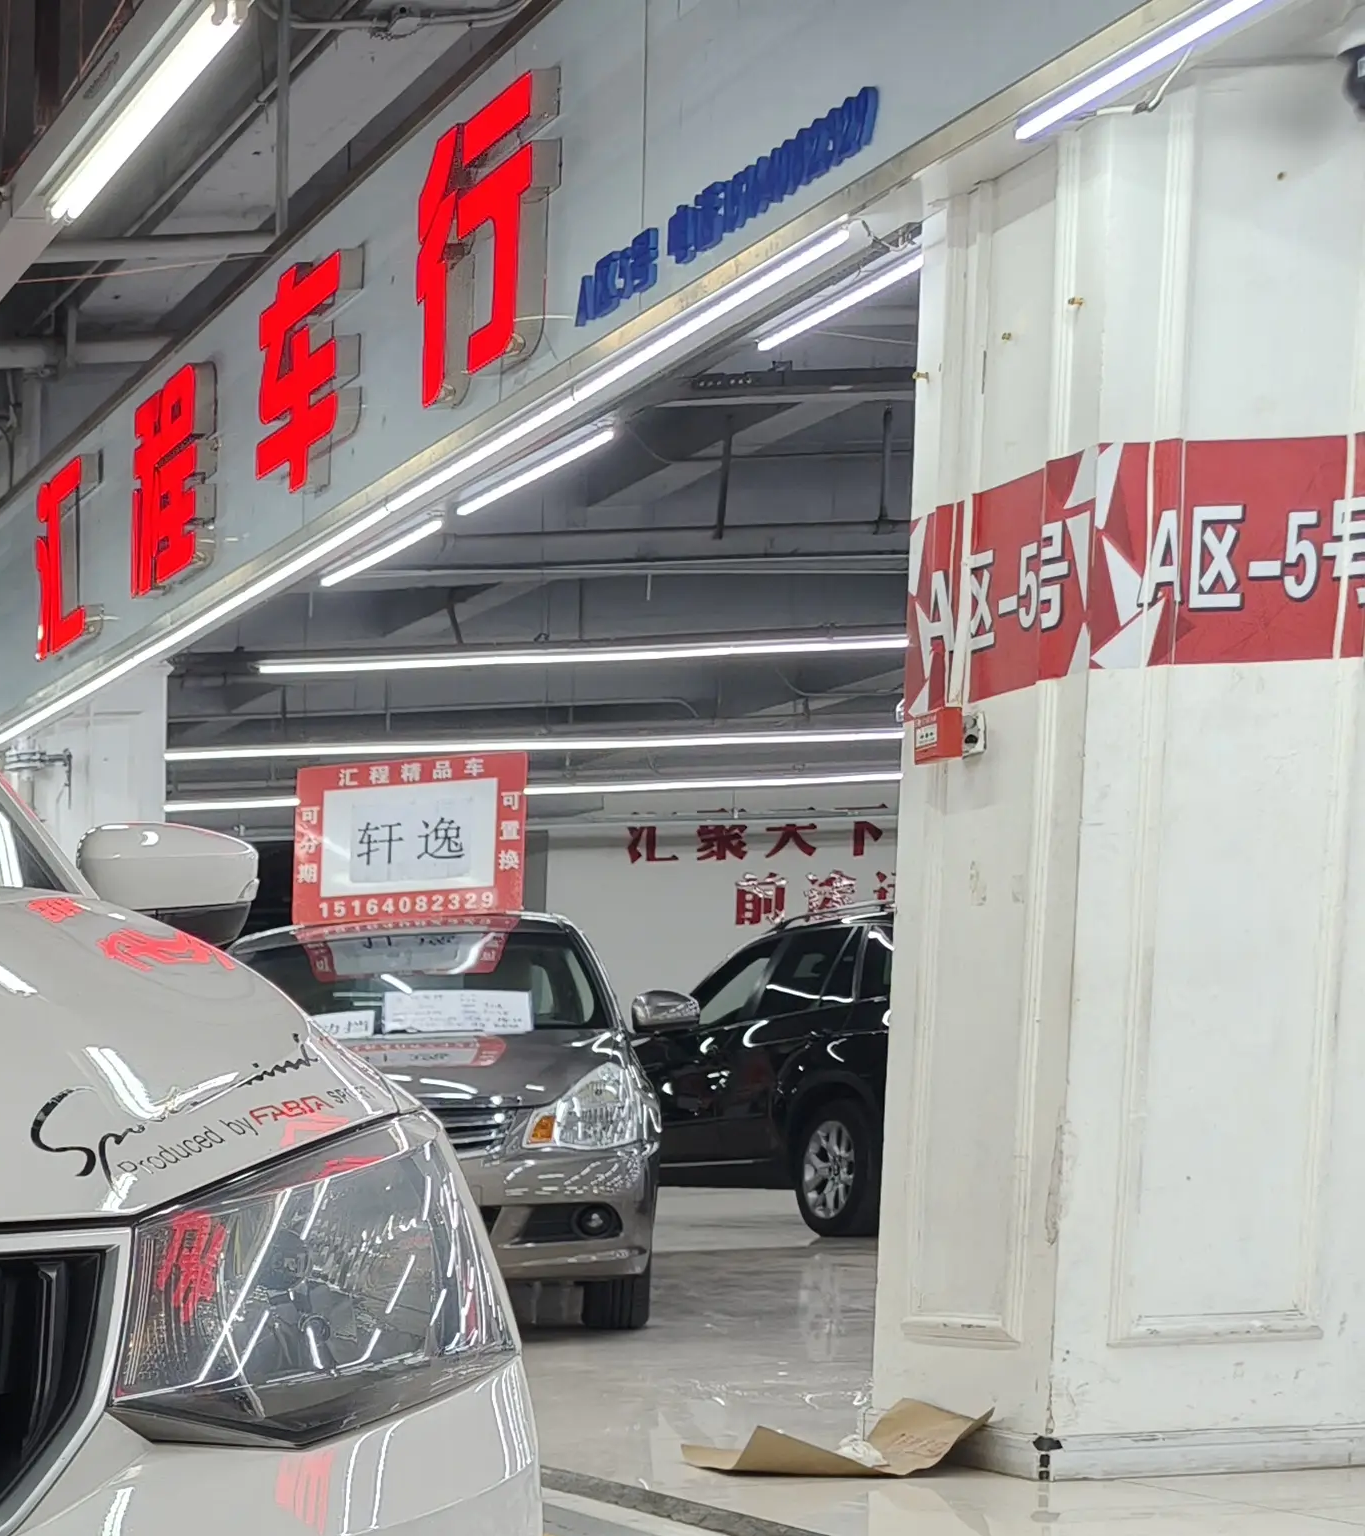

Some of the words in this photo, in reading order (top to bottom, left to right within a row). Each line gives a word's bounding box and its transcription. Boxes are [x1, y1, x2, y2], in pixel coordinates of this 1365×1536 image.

[34, 68, 534, 662] 汇程车行
[924, 520, 1069, 652] A区-5号
[339, 758, 485, 787] 汇程精品车
[297, 806, 320, 884] 可分期
[356, 816, 466, 867] 轩逸
[498, 791, 522, 871] 可置换
[319, 890, 495, 918] 15164082329
[116, 1125, 226, 1175] Produced
[219, 1117, 259, 1136] by
